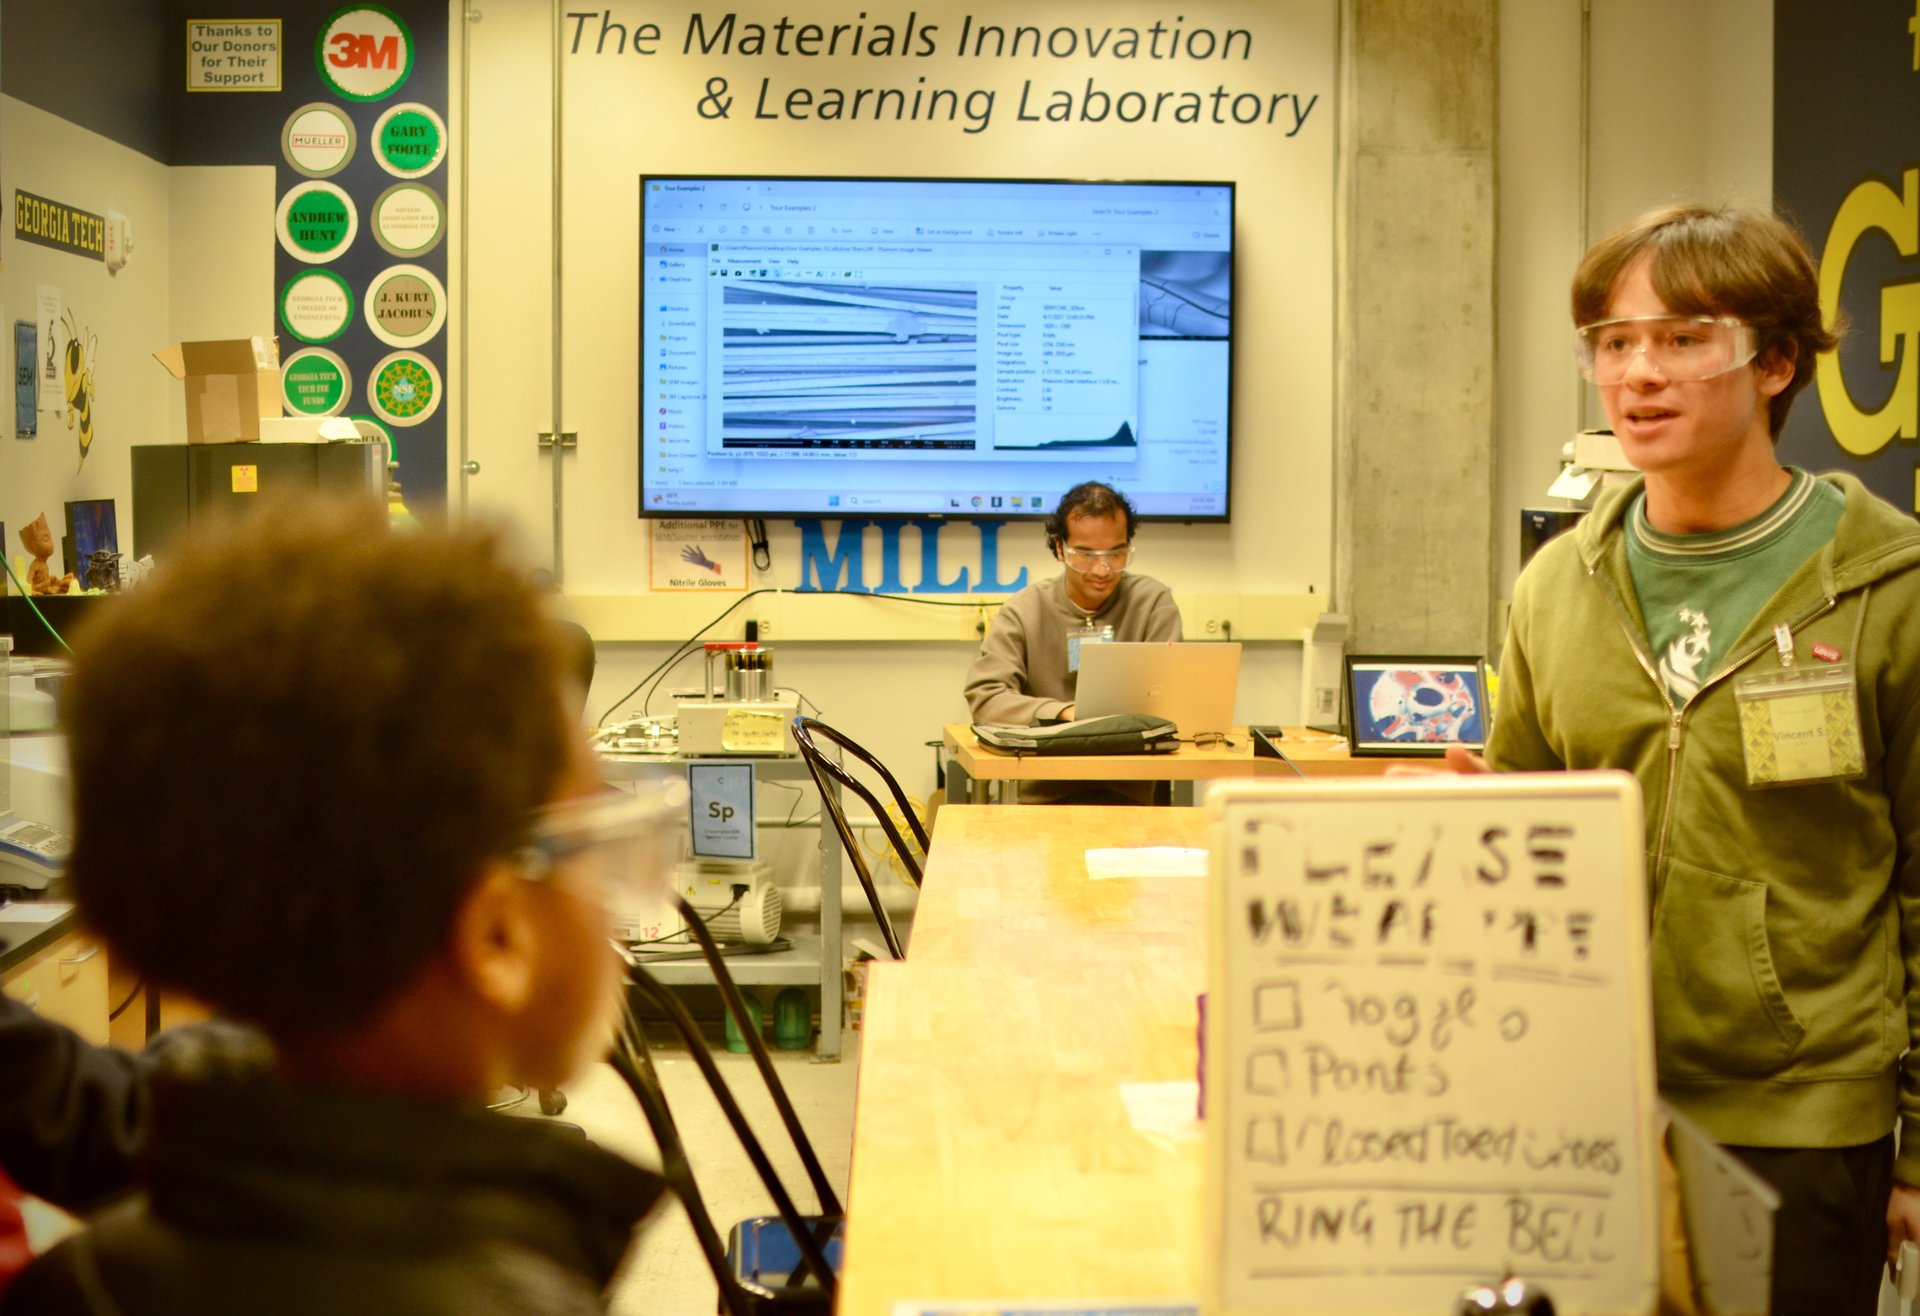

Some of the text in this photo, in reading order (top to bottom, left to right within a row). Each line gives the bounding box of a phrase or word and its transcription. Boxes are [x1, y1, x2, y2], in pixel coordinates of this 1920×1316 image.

[196, 25, 273, 37] Thanks to
[566, 10, 1252, 60] The Materials Innovation
[192, 40, 277, 52] Our Donors
[328, 32, 399, 70] 3M
[201, 56, 267, 67] for Their
[204, 71, 264, 85] Support
[697, 76, 1318, 137] & Learning Laboratory
[390, 125, 427, 137] GARY
[295, 137, 341, 145] MUELLER
[388, 144, 431, 155] FOOTE
[290, 211, 346, 223] ANDREW
[16, 194, 103, 253] GEORGIA TECH
[300, 230, 337, 241] HUNT
[380, 293, 430, 303] J. KURT
[378, 308, 433, 319] JACOBUS
[18, 366, 33, 387] SEM
[393, 383, 415, 394] NSF
[659, 521, 707, 529] Additional
[709, 521, 726, 529] PPE
[794, 520, 1027, 593] MILL
[1772, 730, 1814, 741] Vincent
[708, 801, 734, 823] Sp
[643, 927, 659, 939] 12
[1257, 1196, 1375, 1249] RING
[1394, 1200, 1478, 1250] THE
